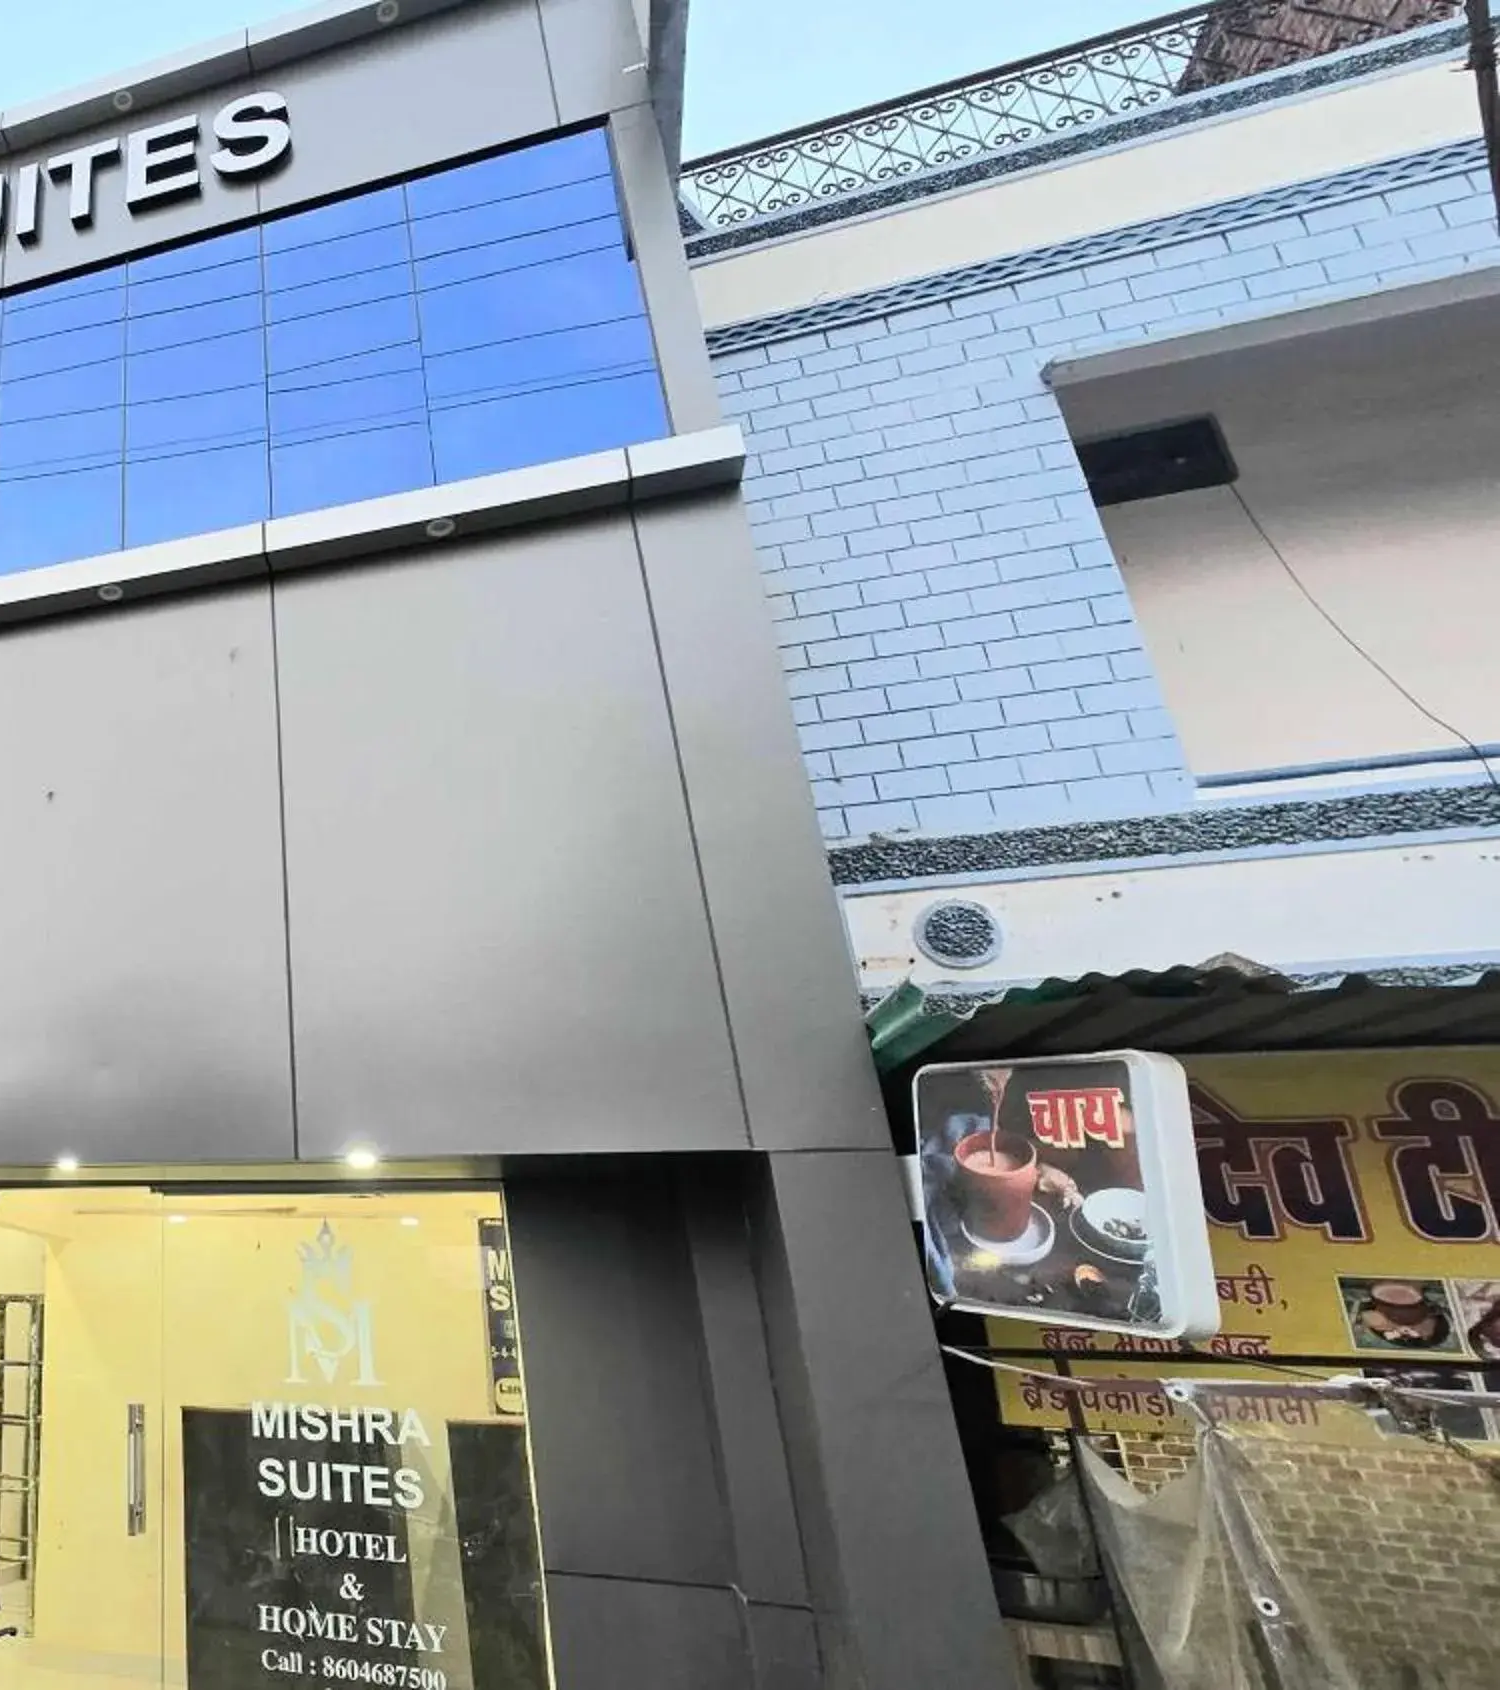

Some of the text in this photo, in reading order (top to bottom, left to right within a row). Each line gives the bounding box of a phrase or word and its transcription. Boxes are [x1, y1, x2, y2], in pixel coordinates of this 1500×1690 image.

[1027, 1087, 1125, 1149] चाय
[251, 1400, 431, 1447] MISHRA
[257, 1457, 425, 1510] SUITES
[295, 1526, 407, 1564] HOTEL
[339, 1573, 364, 1601] &
[257, 1603, 447, 1653] HOME STAY
[261, 1649, 303, 1675] Call
[322, 1656, 447, 1690] 8604687500
